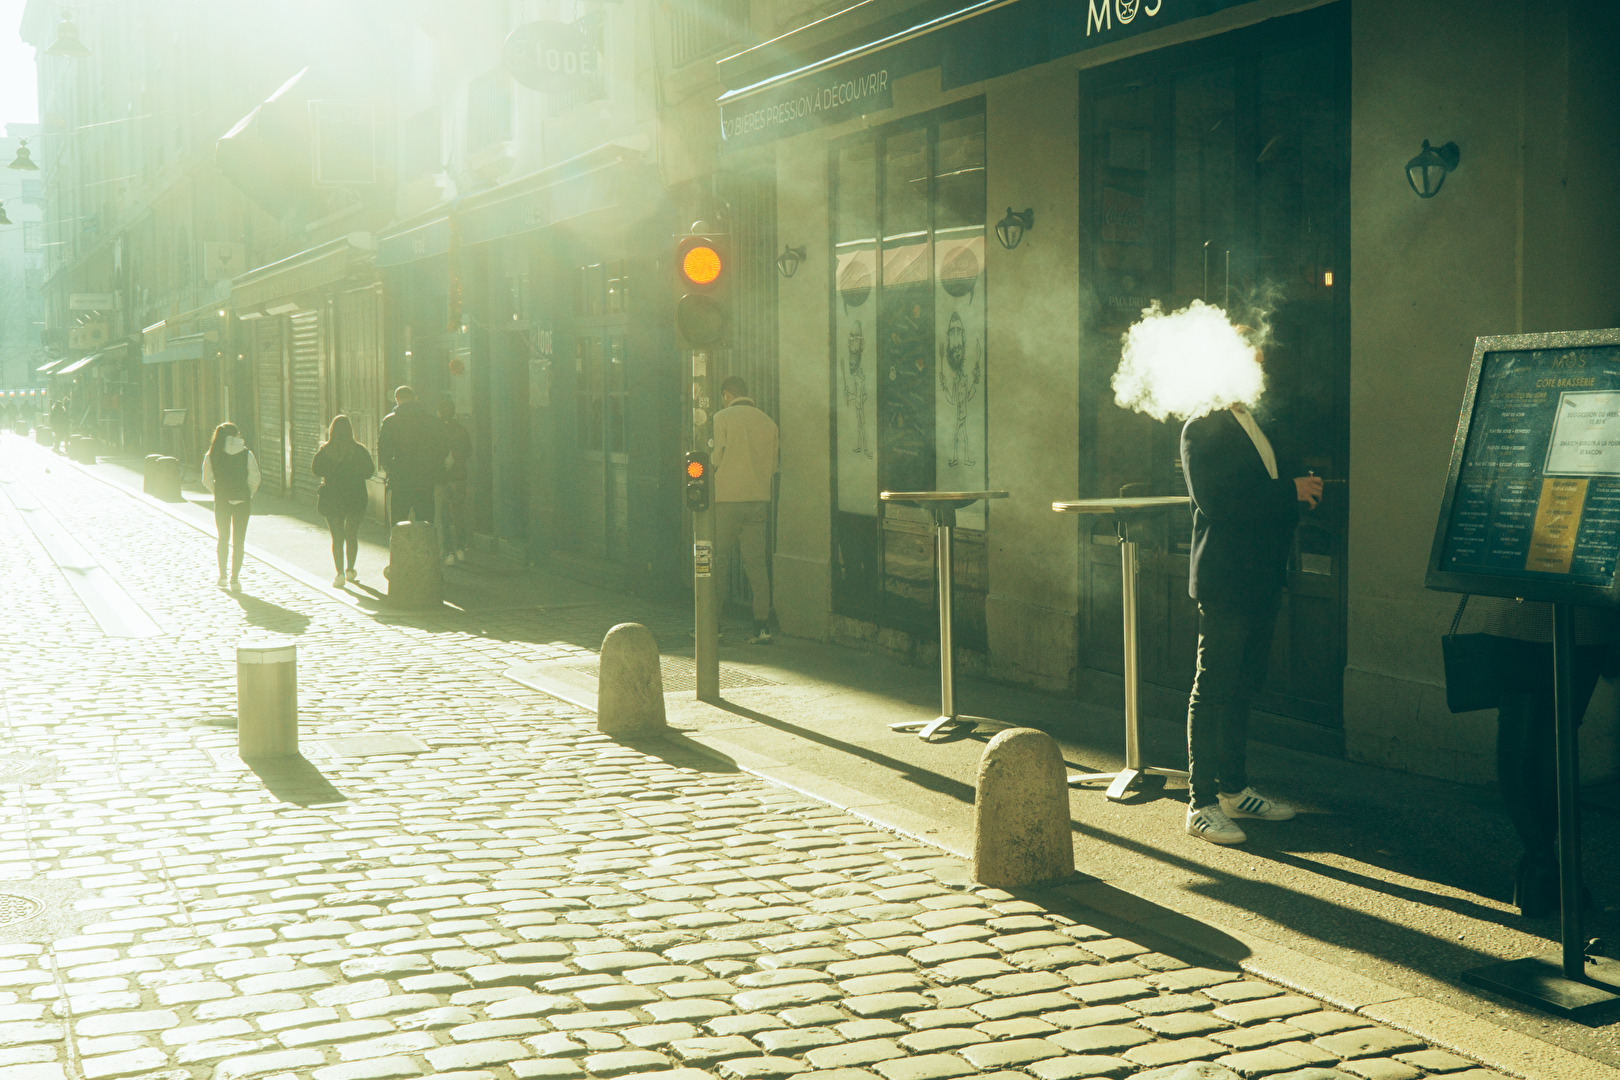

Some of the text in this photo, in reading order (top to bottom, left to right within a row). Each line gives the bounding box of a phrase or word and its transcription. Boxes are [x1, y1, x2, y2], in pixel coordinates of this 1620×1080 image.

[735, 109, 766, 136] BIÈRES
[766, 95, 813, 128] PRESSION
[813, 87, 822, 113] À
[824, 69, 888, 110] DÉCOUVRIR
[1557, 377, 1596, 387] BRASSERIE
